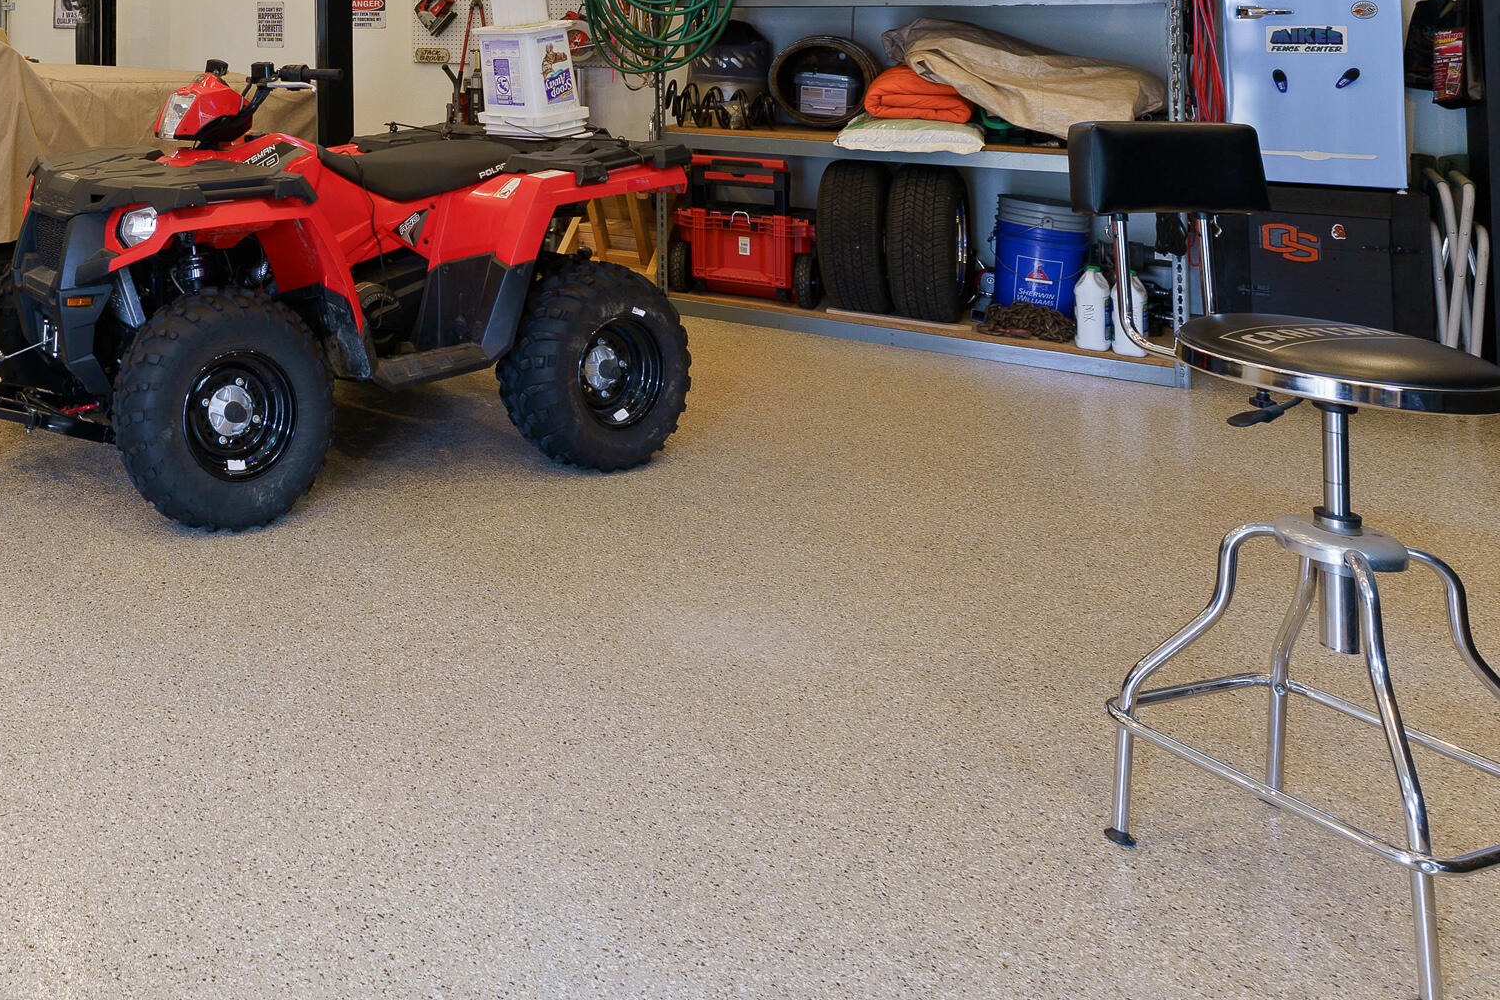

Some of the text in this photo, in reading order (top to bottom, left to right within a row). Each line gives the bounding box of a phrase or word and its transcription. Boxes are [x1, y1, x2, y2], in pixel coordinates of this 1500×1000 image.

[258, 12, 283, 20] HAPPINESS
[262, 24, 283, 32] CORVETTE
[1270, 26, 1344, 45] MIKE'S
[1271, 45, 1343, 53] FENCE CENTER
[243, 143, 276, 165] TSMAN
[1018, 287, 1055, 300] SHERWIN
[1016, 294, 1055, 307] WILLIAMS
[1082, 304, 1095, 323] MIX
